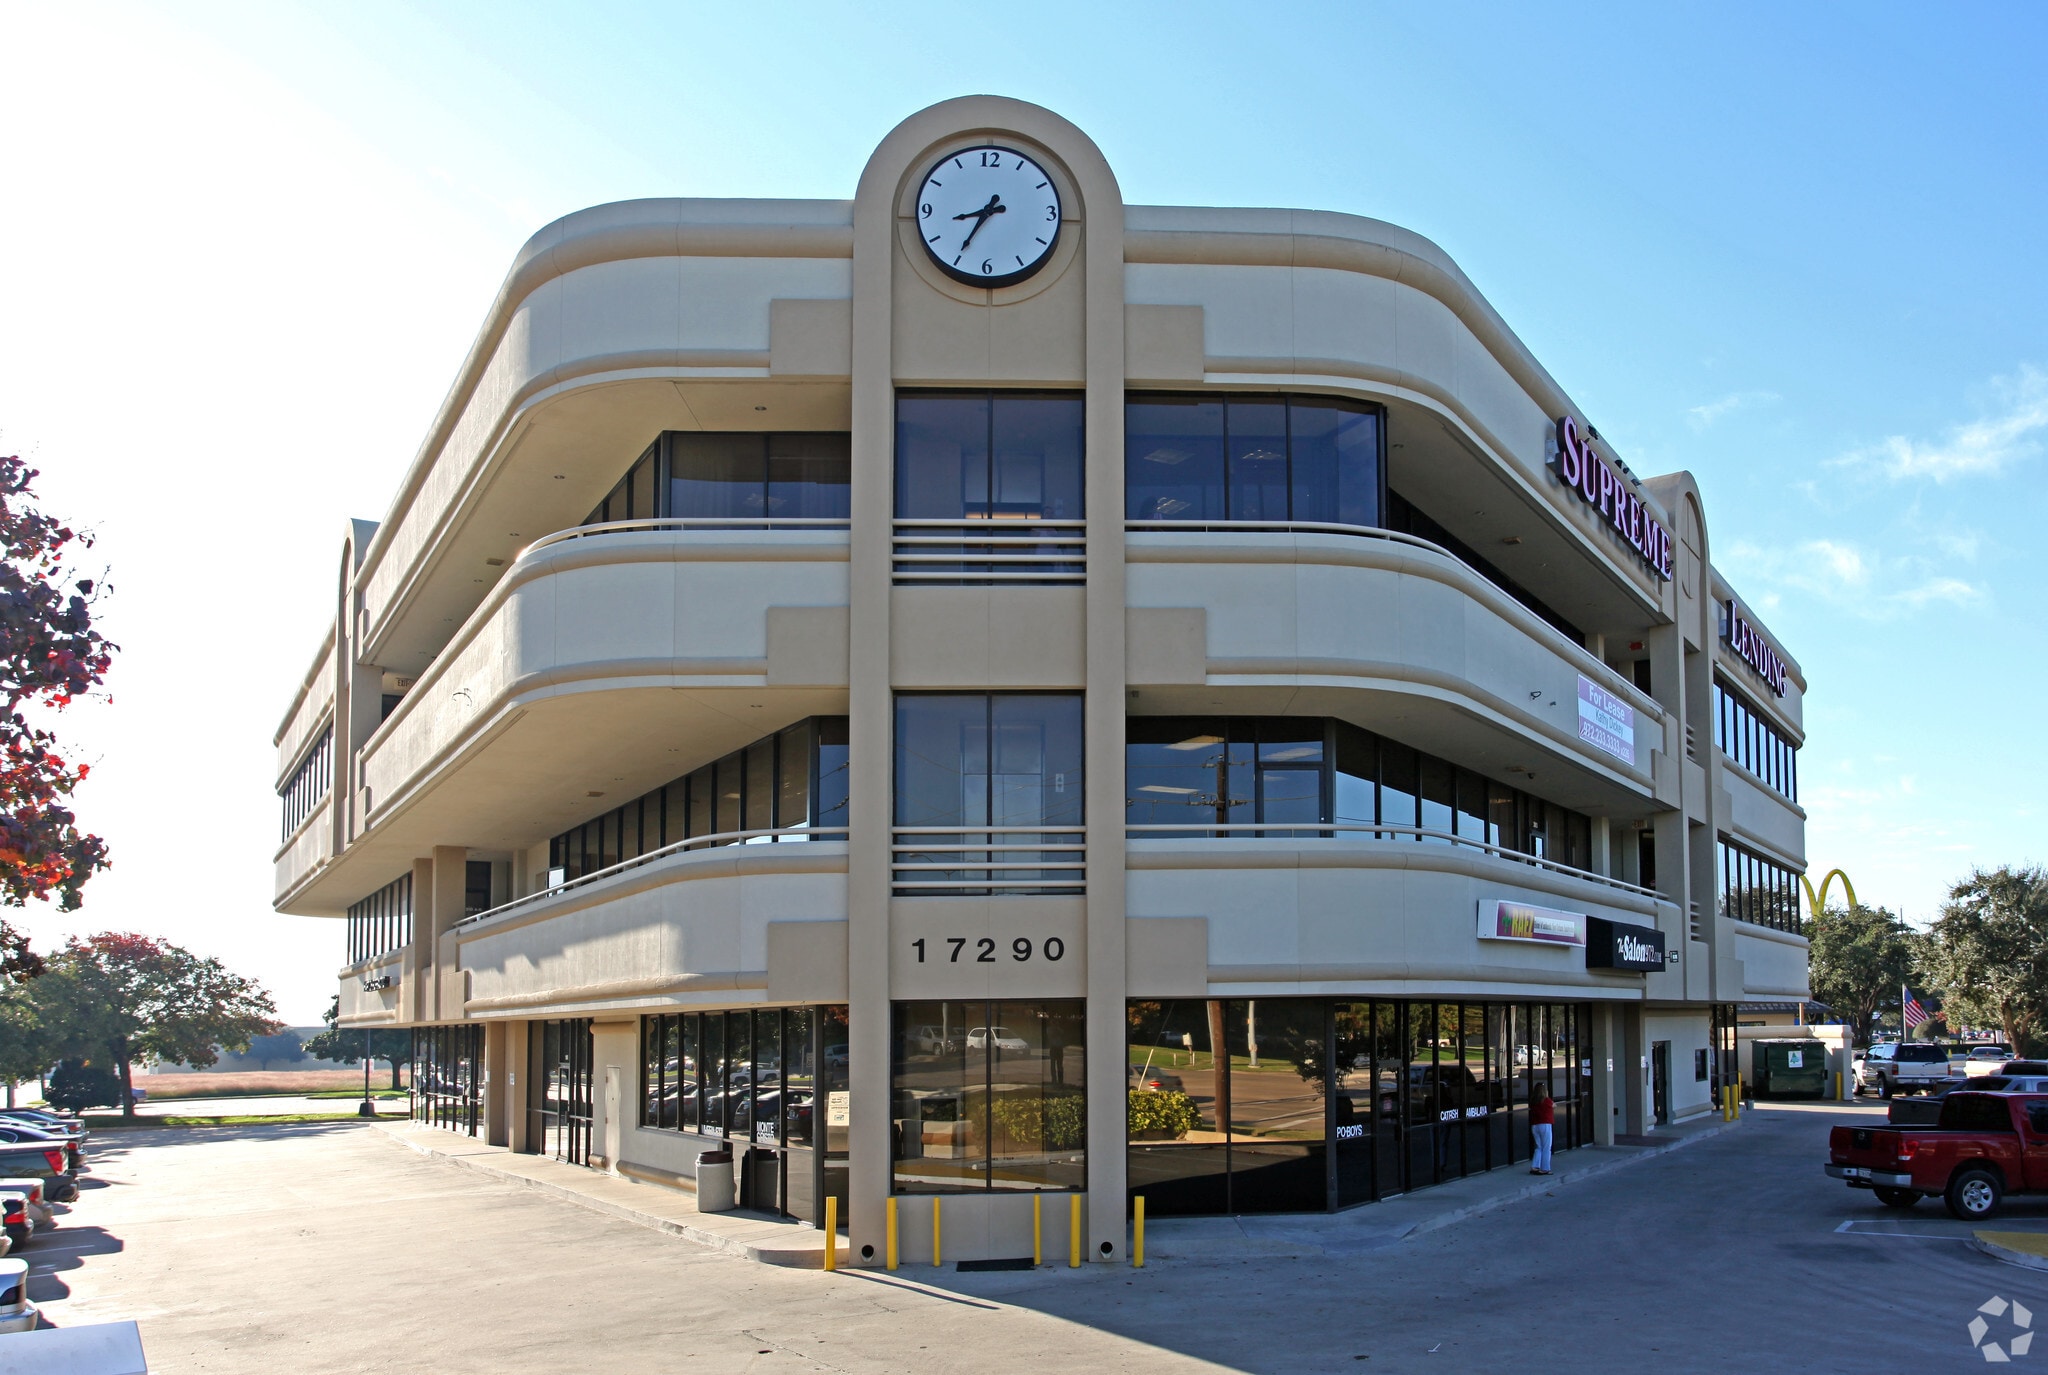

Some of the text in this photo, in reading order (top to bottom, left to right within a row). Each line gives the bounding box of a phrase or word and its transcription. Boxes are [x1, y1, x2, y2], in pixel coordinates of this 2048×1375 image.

[980, 152, 1000, 168] 12
[921, 203, 933, 219] 9
[1046, 205, 1057, 221] 3
[981, 258, 993, 274] 6
[1557, 416, 1672, 582] SUPREME
[1726, 600, 1787, 698] LENDING
[1589, 685, 1625, 720] For Lease
[911, 937, 1065, 963] 17290
